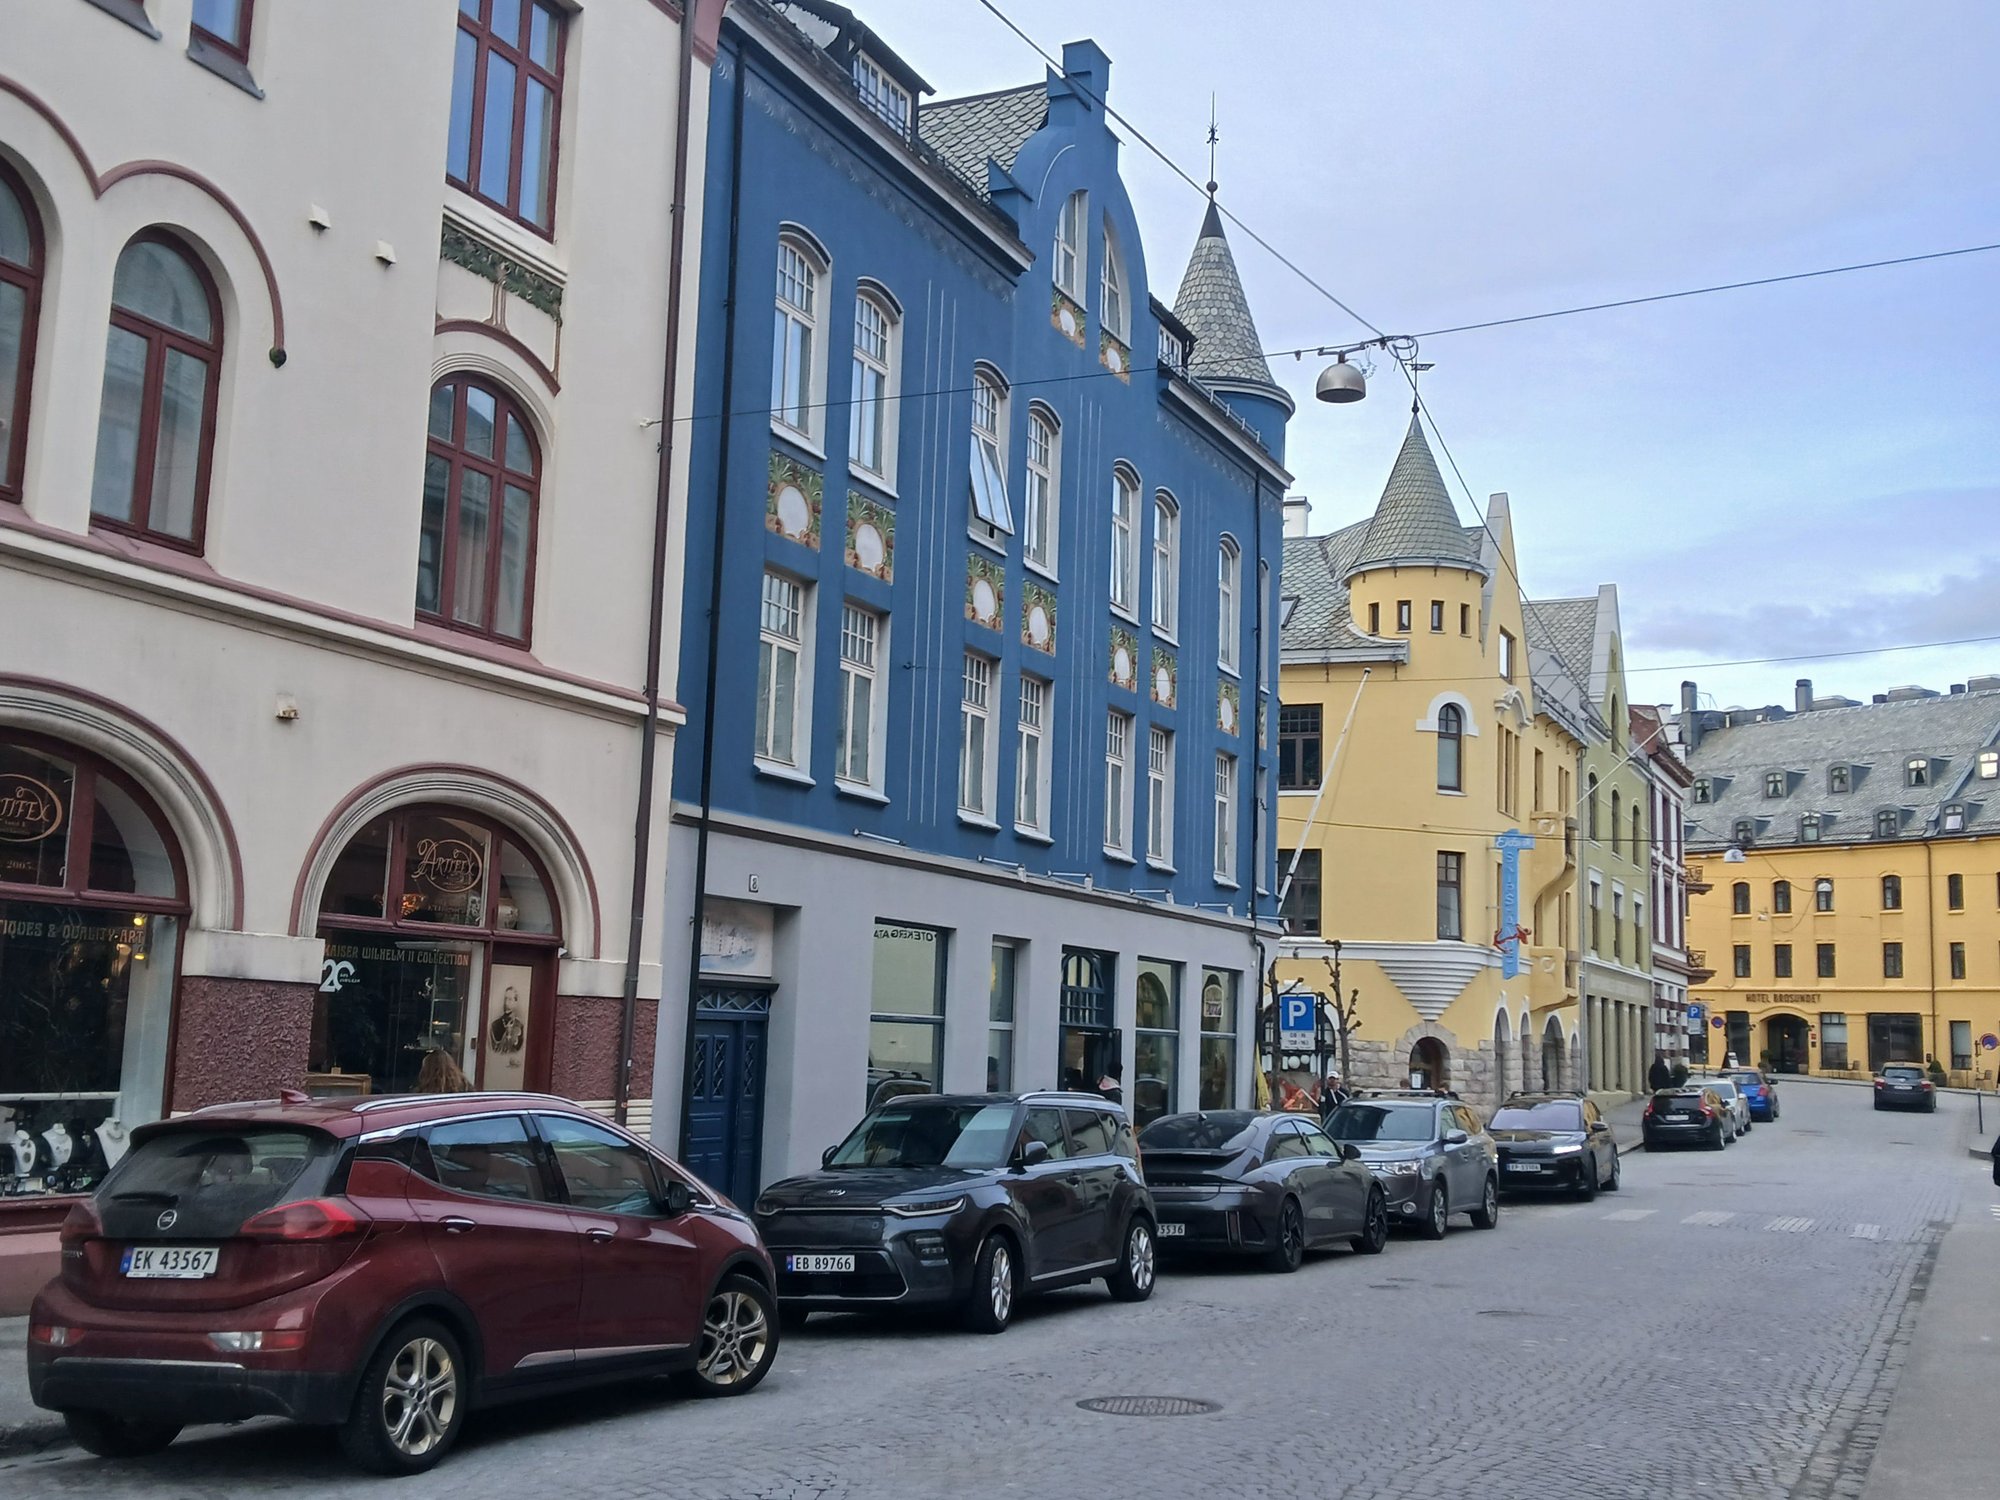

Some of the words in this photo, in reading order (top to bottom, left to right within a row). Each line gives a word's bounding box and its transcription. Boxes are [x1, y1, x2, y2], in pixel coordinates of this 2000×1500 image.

[47, 923, 57, 938] &
[62, 924, 116, 942] QUALITY
[324, 944, 358, 959] KAISER
[362, 947, 405, 962] WILHELM
[417, 951, 469, 966] COLLECTION
[1746, 994, 1770, 1003] HOTEL
[1289, 1001, 1306, 1026] P
[1690, 1007, 1698, 1017] P
[1156, 1225, 1183, 1234] 5536
[134, 1251, 154, 1269] EK
[159, 1251, 213, 1270] 43567
[796, 1257, 809, 1269] EB
[814, 1257, 851, 1270] 89766
